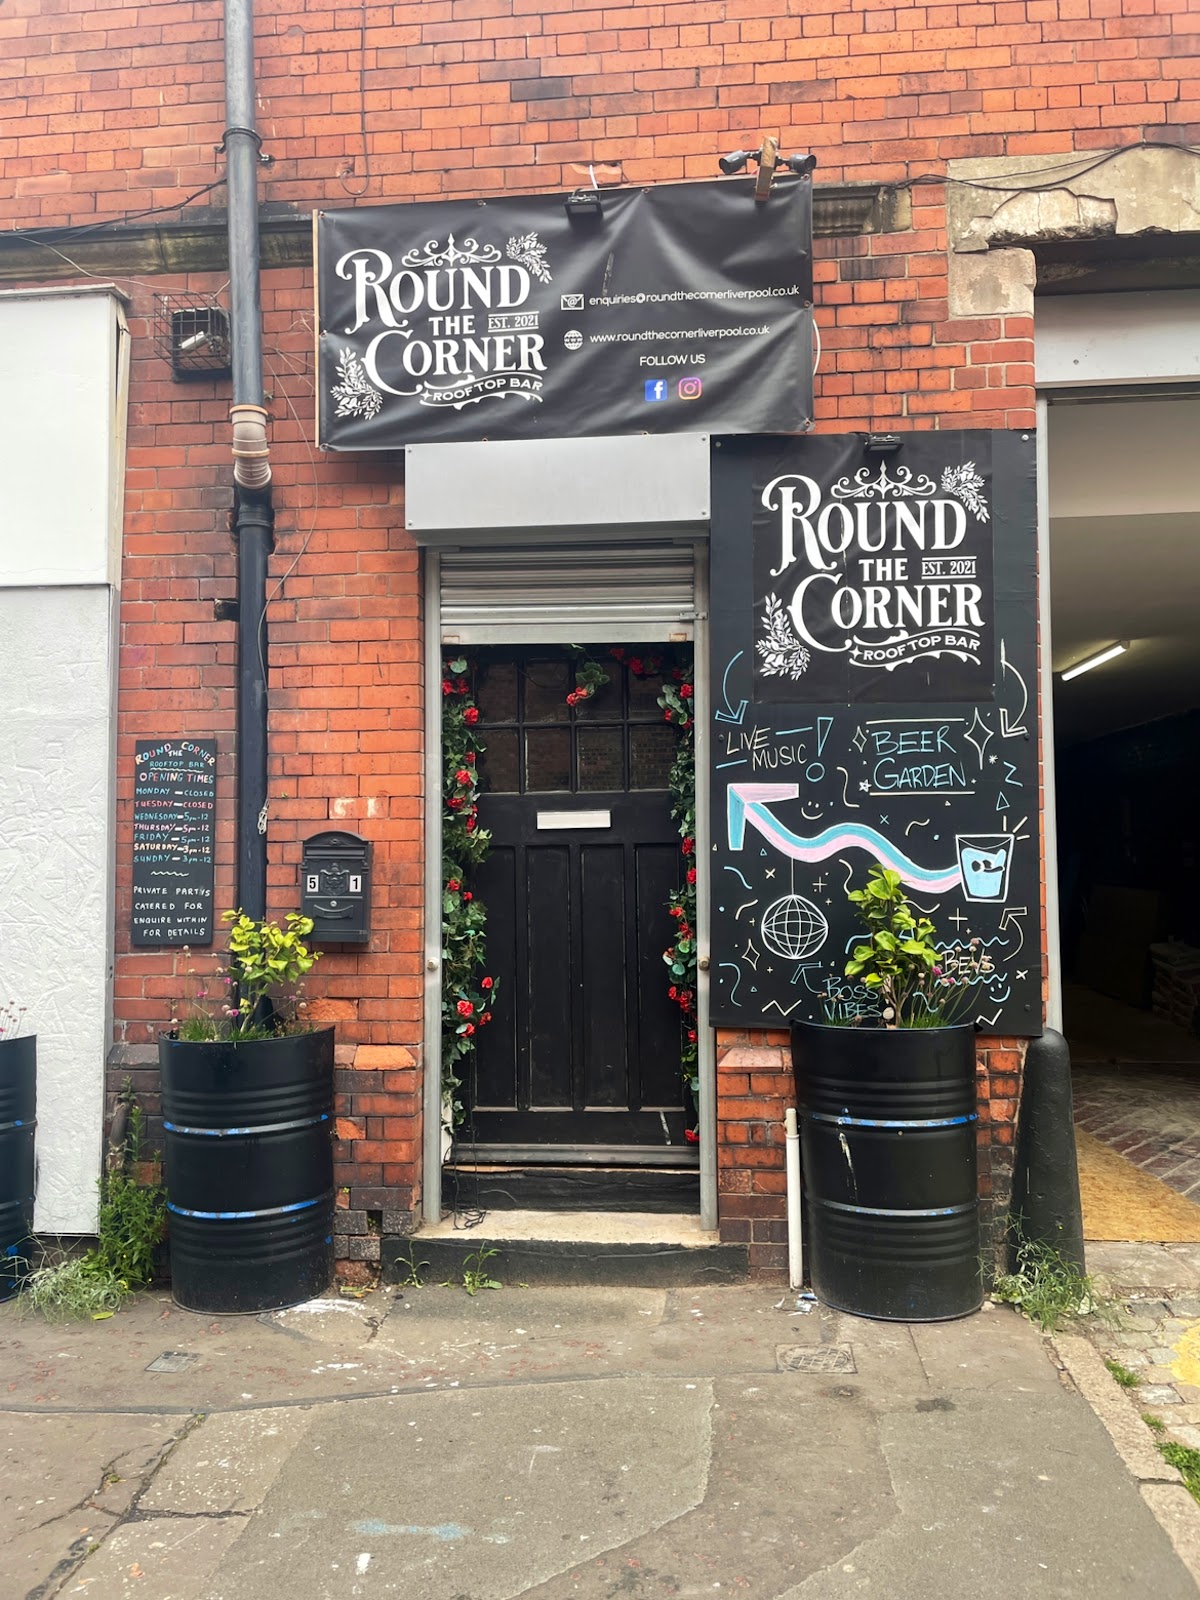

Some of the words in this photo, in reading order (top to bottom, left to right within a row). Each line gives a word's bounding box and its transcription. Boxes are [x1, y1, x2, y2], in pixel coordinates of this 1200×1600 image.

[335, 248, 531, 335] ROUND
[428, 315, 476, 336] THE
[488, 317, 511, 329] EST.
[514, 314, 539, 327] 2021
[590, 325, 770, 343] www.roundthecornerliverpool.co.uk
[360, 329, 548, 396] CORNER
[639, 356, 688, 366] FOLLOW
[690, 354, 706, 364] US
[433, 378, 506, 401] ROOFTOP
[510, 377, 544, 391] BAR
[761, 474, 967, 576] ROUND
[858, 558, 909, 581] THE
[921, 561, 946, 575] EST.
[950, 560, 976, 575] 2021
[787, 573, 985, 652] CORNER
[863, 635, 941, 661] ROOFTOP
[944, 634, 981, 651] BAR
[726, 724, 771, 755] LIVE
[871, 725, 957, 755] BEER
[135, 743, 172, 765] ROUND
[168, 749, 183, 757] THE
[181, 741, 215, 766] CORNER
[752, 743, 807, 771] MUSIC
[139, 772, 183, 782] OPENING
[187, 773, 214, 785] TIMES
[873, 757, 966, 790] GARDEN
[136, 787, 171, 795] MONDAY
[184, 789, 214, 797] CLOSED
[135, 800, 173, 808] TUESDAY
[182, 801, 214, 809] CLOSED
[134, 812, 178, 820] WEDNESDAY
[133, 823, 176, 833] THURSDAY
[133, 832, 169, 842] FRIDAY
[133, 843, 178, 851] SATURDAY
[133, 854, 171, 863] SUNDAY
[133, 885, 168, 895] PRIVATE
[175, 887, 211, 897] PARTYS
[309, 877, 316, 889] 5
[352, 877, 358, 889] 1
[134, 902, 176, 911] CATERED
[184, 901, 203, 910] FOR
[133, 916, 172, 925] ENQUIRE
[176, 916, 208, 924] WITHIN
[143, 928, 161, 938] FOR
[167, 927, 206, 937] DETAILS
[822, 976, 879, 1002] BOSS
[824, 1001, 882, 1020] VIBES
